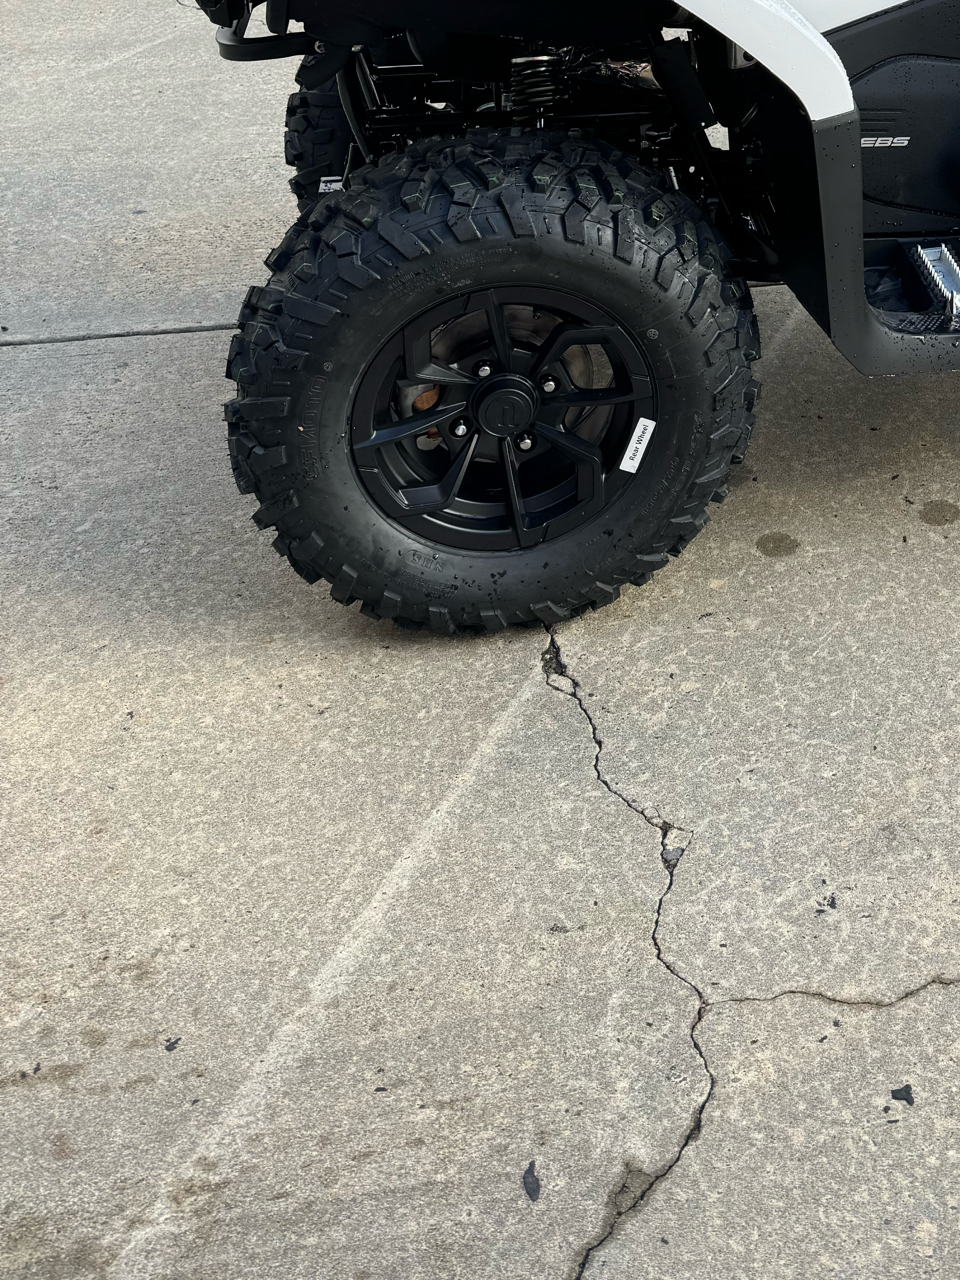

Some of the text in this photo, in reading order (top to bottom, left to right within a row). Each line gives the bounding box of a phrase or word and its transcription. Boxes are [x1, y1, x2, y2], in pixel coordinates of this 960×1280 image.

[860, 136, 911, 148] EBS
[629, 424, 649, 461] Rear Wheel
